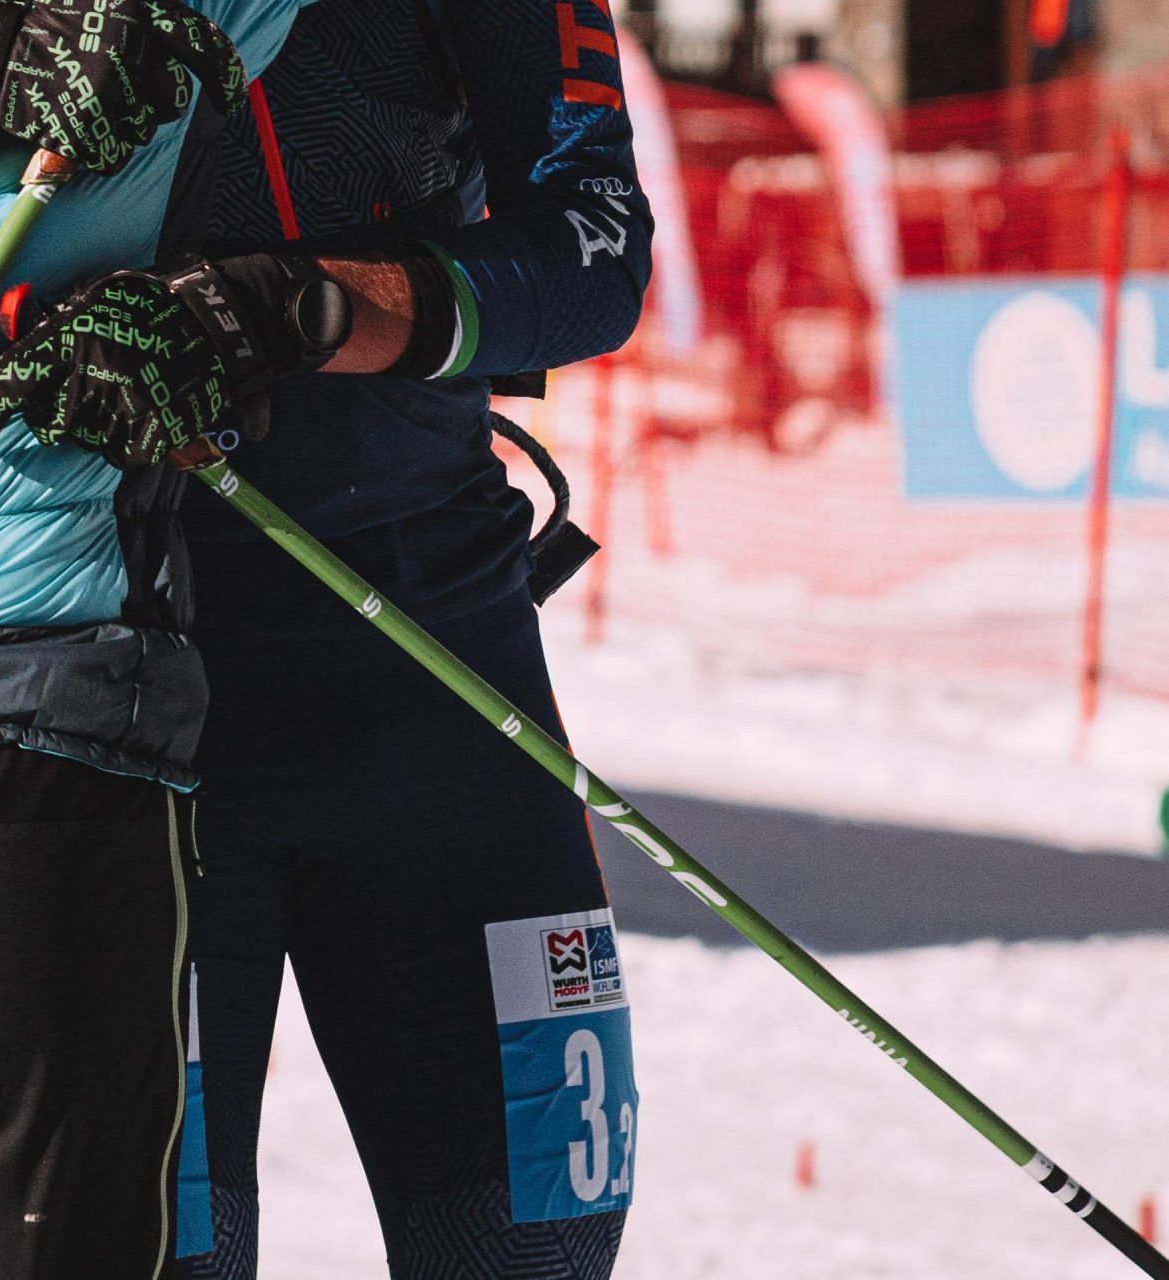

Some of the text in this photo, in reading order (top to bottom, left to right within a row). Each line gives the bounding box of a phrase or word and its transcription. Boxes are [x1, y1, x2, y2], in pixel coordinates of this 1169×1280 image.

[47, 36, 118, 156] KARPOS
[61, 314, 172, 360] KARPO
[197, 283, 253, 358] LEK
